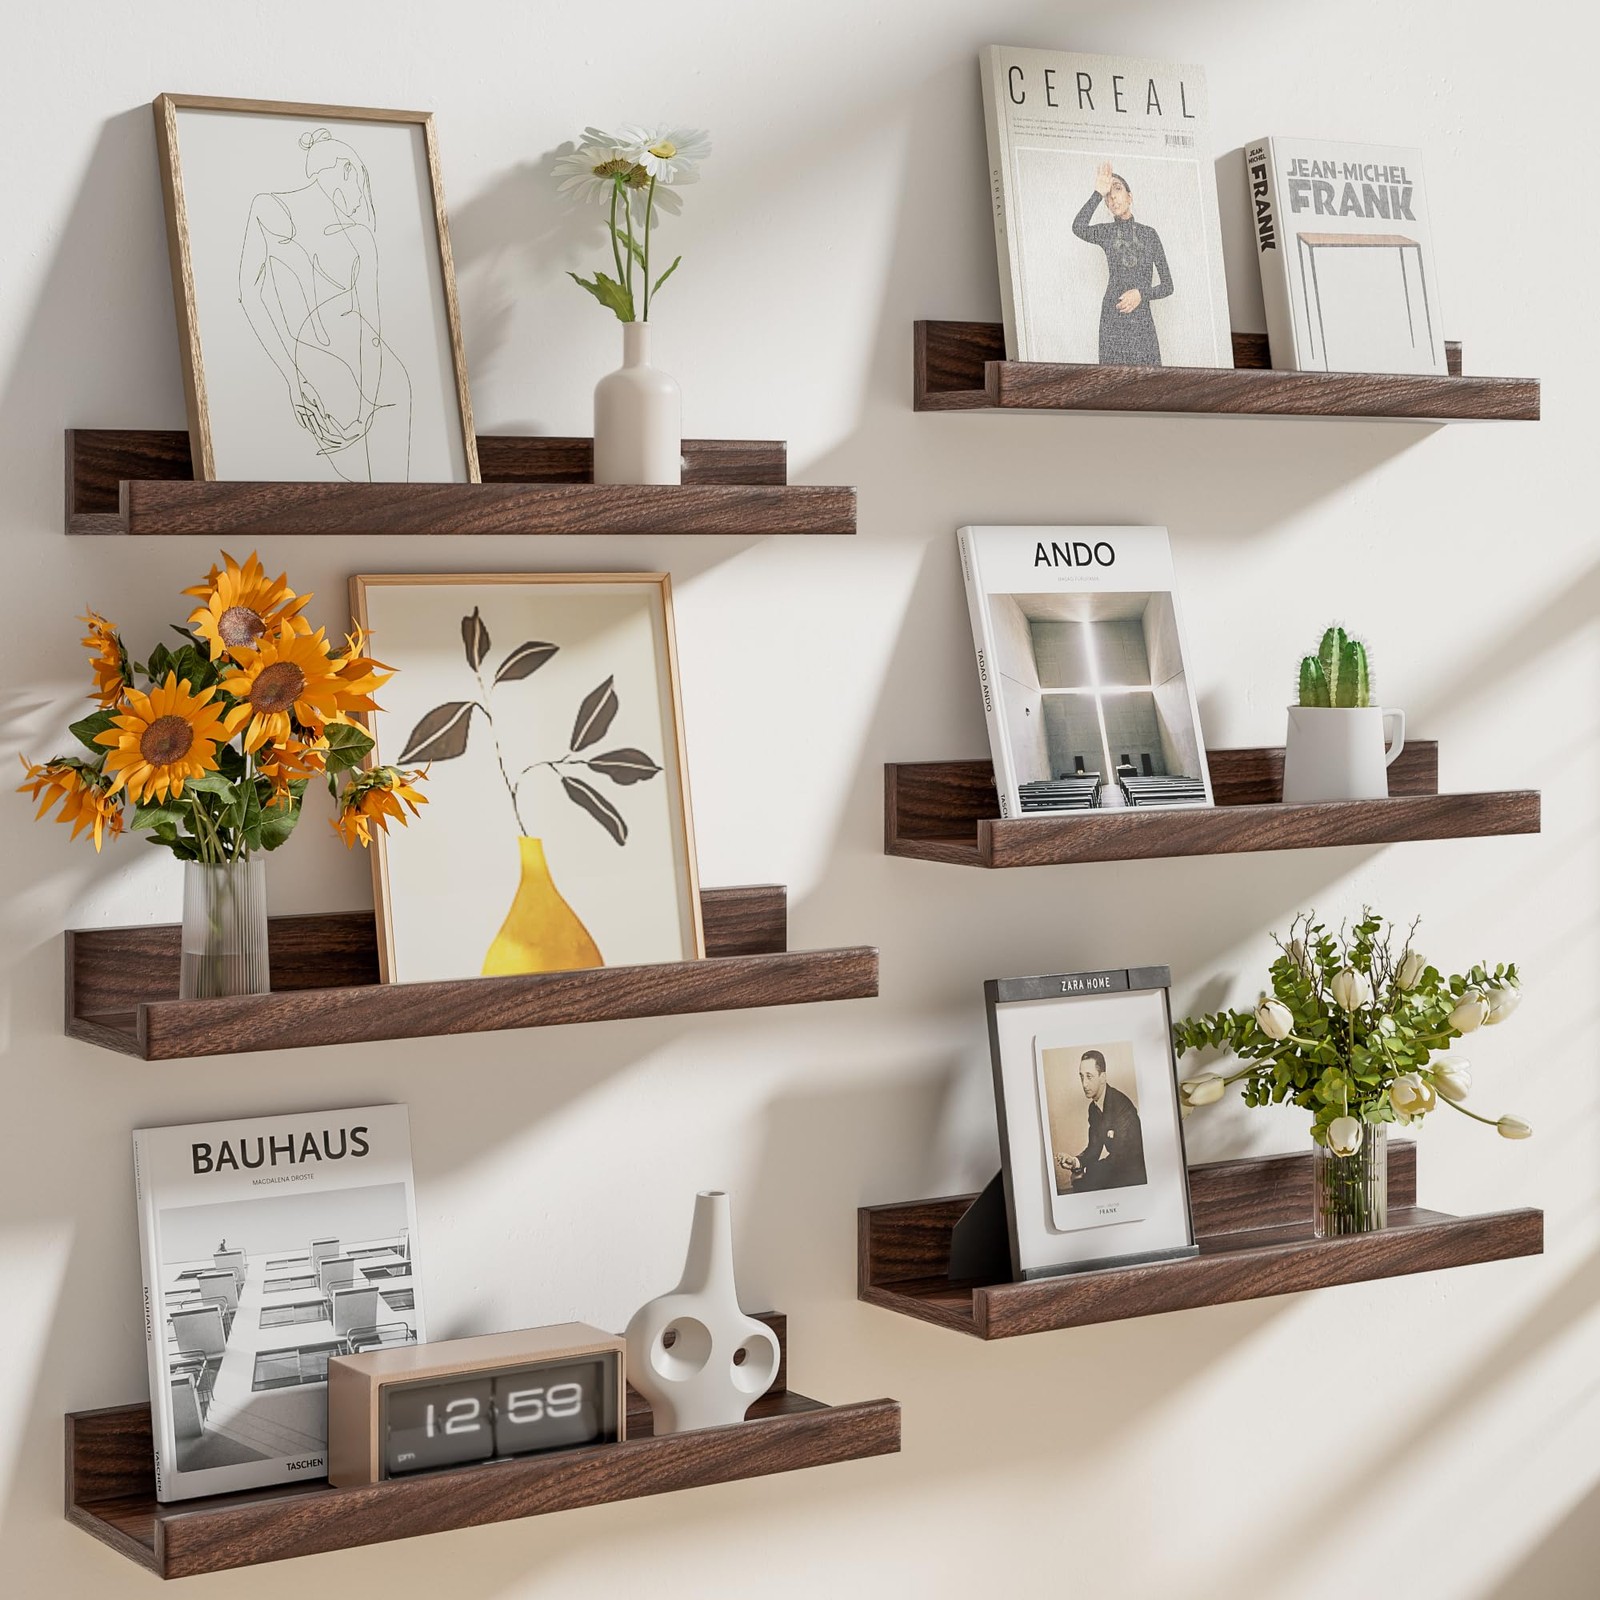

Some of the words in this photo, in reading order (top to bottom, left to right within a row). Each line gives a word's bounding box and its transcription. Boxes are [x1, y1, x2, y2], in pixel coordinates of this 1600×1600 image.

[1008, 65, 1195, 119] CEREAL
[1248, 154, 1267, 164] MICHEL
[1287, 158, 1413, 185] JEAN-MICHEL
[1251, 163, 1276, 252] FRANK
[1288, 178, 1416, 221] FRANK
[1034, 541, 1115, 567] ANDO
[977, 648, 988, 681] TADAO
[982, 684, 992, 712] ANDO
[1061, 979, 1084, 991] ZARA
[1086, 977, 1110, 989] HOME
[192, 1126, 370, 1174] BAUHAUS
[252, 1176, 290, 1185] MAGDALENA
[291, 1173, 314, 1181] DROSTE
[427, 1397, 480, 1438] 12
[508, 1383, 582, 1423] 59
[286, 1458, 323, 1471] TASCHEN
